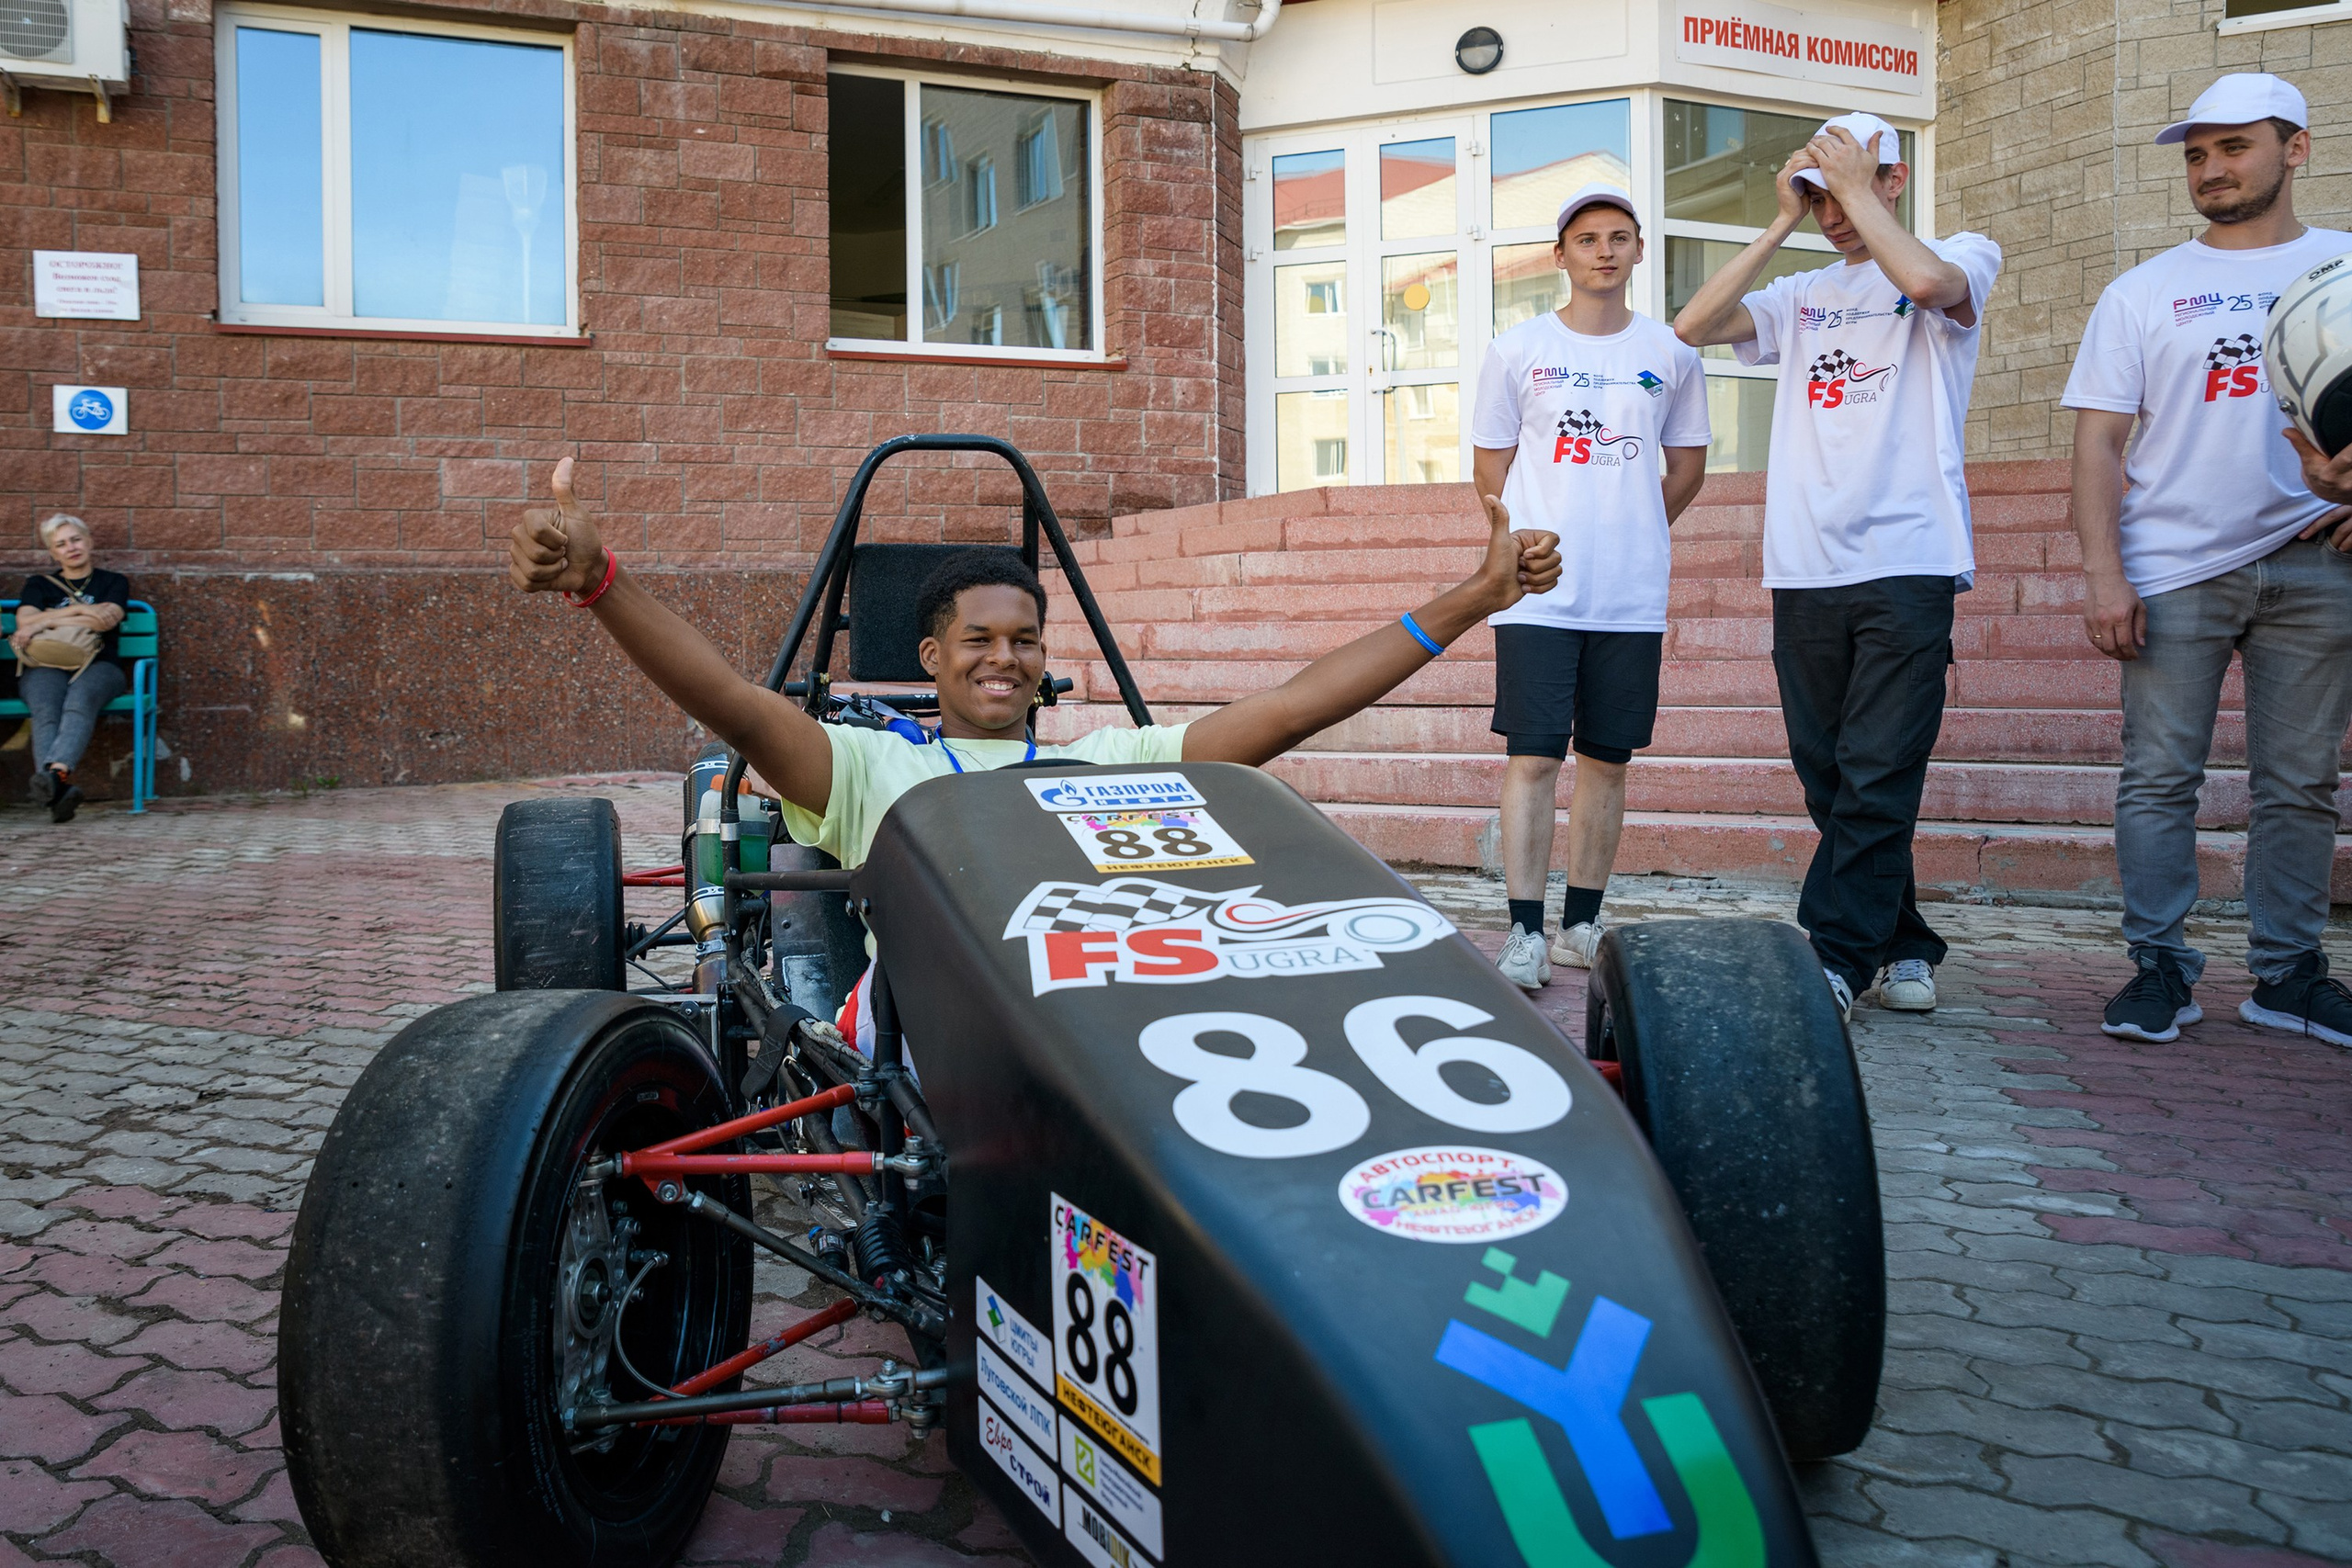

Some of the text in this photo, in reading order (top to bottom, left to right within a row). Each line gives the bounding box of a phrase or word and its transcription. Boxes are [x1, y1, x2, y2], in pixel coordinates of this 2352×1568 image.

[1683, 16, 1918, 76] ПРИЁМНАЯ КОМИССИЯ
[2308, 258, 2344, 280] OMP
[2227, 294, 2253, 311] 25
[1827, 310, 1843, 329] 25
[1532, 367, 1590, 388] РМЦ 25
[2204, 366, 2259, 402] FS
[1808, 379, 1877, 409] FS UGRA
[1554, 436, 1621, 467] FS UGRA
[1085, 782, 1187, 797] ГАЗПРОМ
[1096, 795, 1195, 806] НЕФТЬ
[1066, 810, 1200, 823] CARFEST
[1095, 827, 1213, 860] 88
[1106, 858, 1242, 871] НЕФТЕЮГАНСК
[1045, 929, 1362, 981] FS UGRA
[1138, 995, 1573, 1159] 86
[1359, 1152, 1515, 1183] АВТОСПОРТ
[1361, 1173, 1545, 1210] CARFEST
[1395, 1209, 1540, 1235] НЕФТЕЮГАНСК
[1056, 1204, 1149, 1281] CARFEST
[1011, 1337, 1035, 1369] ЮГРЫ
[1066, 1272, 1138, 1416] 88
[981, 1356, 1027, 1416] Луговской
[1030, 1403, 1052, 1438] ЛПК
[986, 1416, 1013, 1454] Евро
[1063, 1384, 1152, 1472] НЕФТЕЮГАНСК
[1010, 1454, 1051, 1507] СТРОЙ
